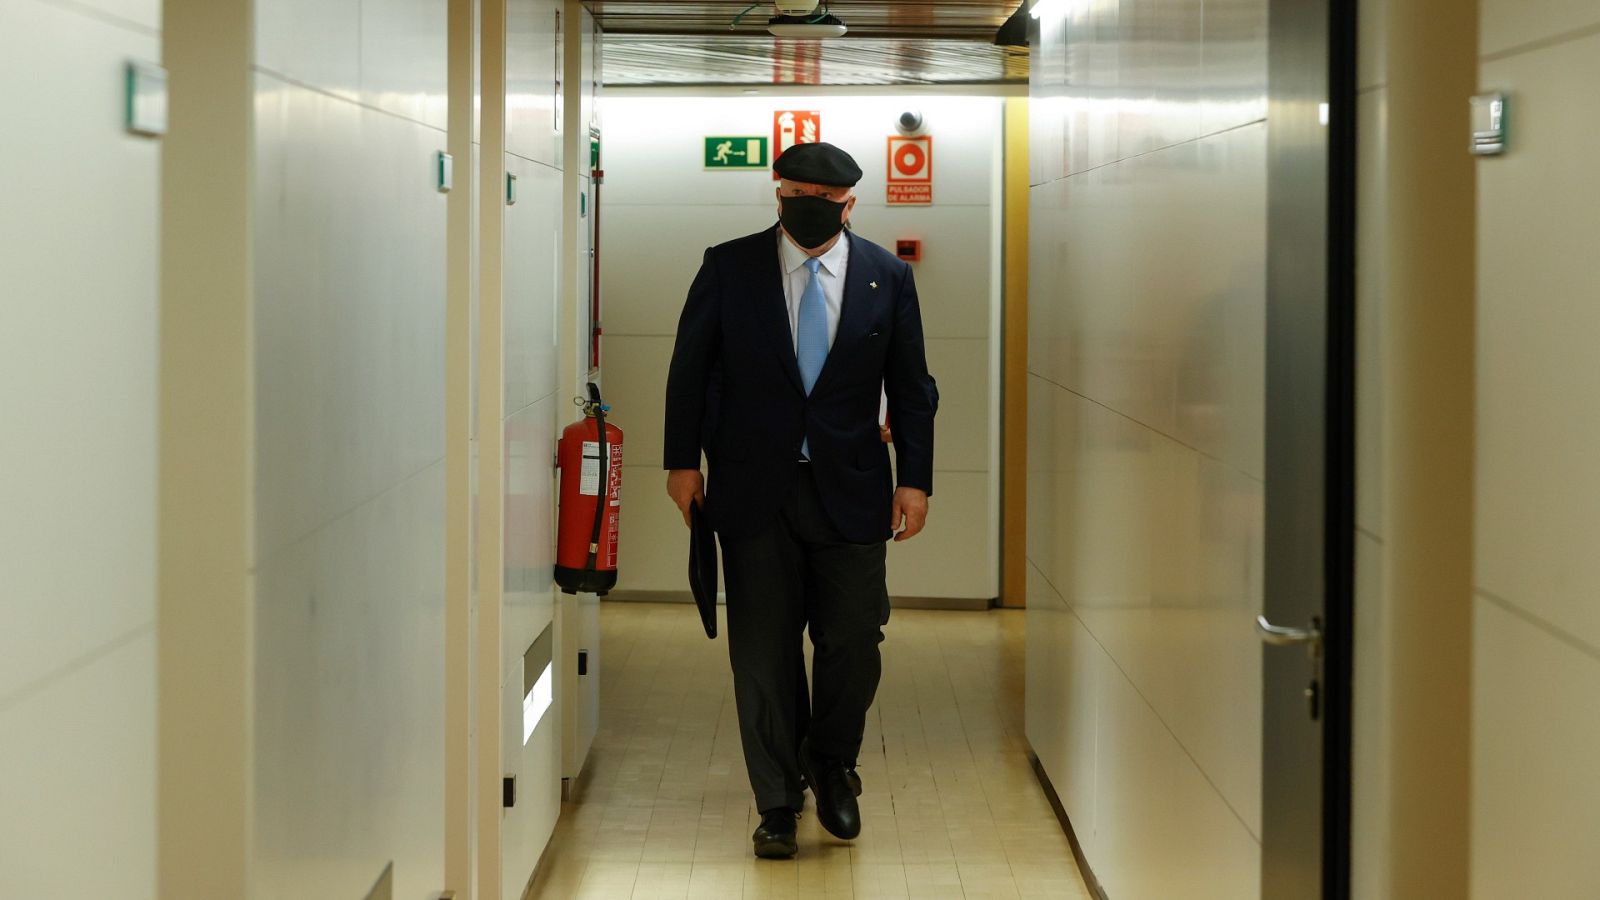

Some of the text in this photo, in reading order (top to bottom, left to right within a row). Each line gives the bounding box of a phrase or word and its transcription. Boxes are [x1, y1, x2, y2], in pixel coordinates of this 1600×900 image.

[888, 185, 929, 193] PULSADOR
[888, 194, 931, 202] DE ALARMA
